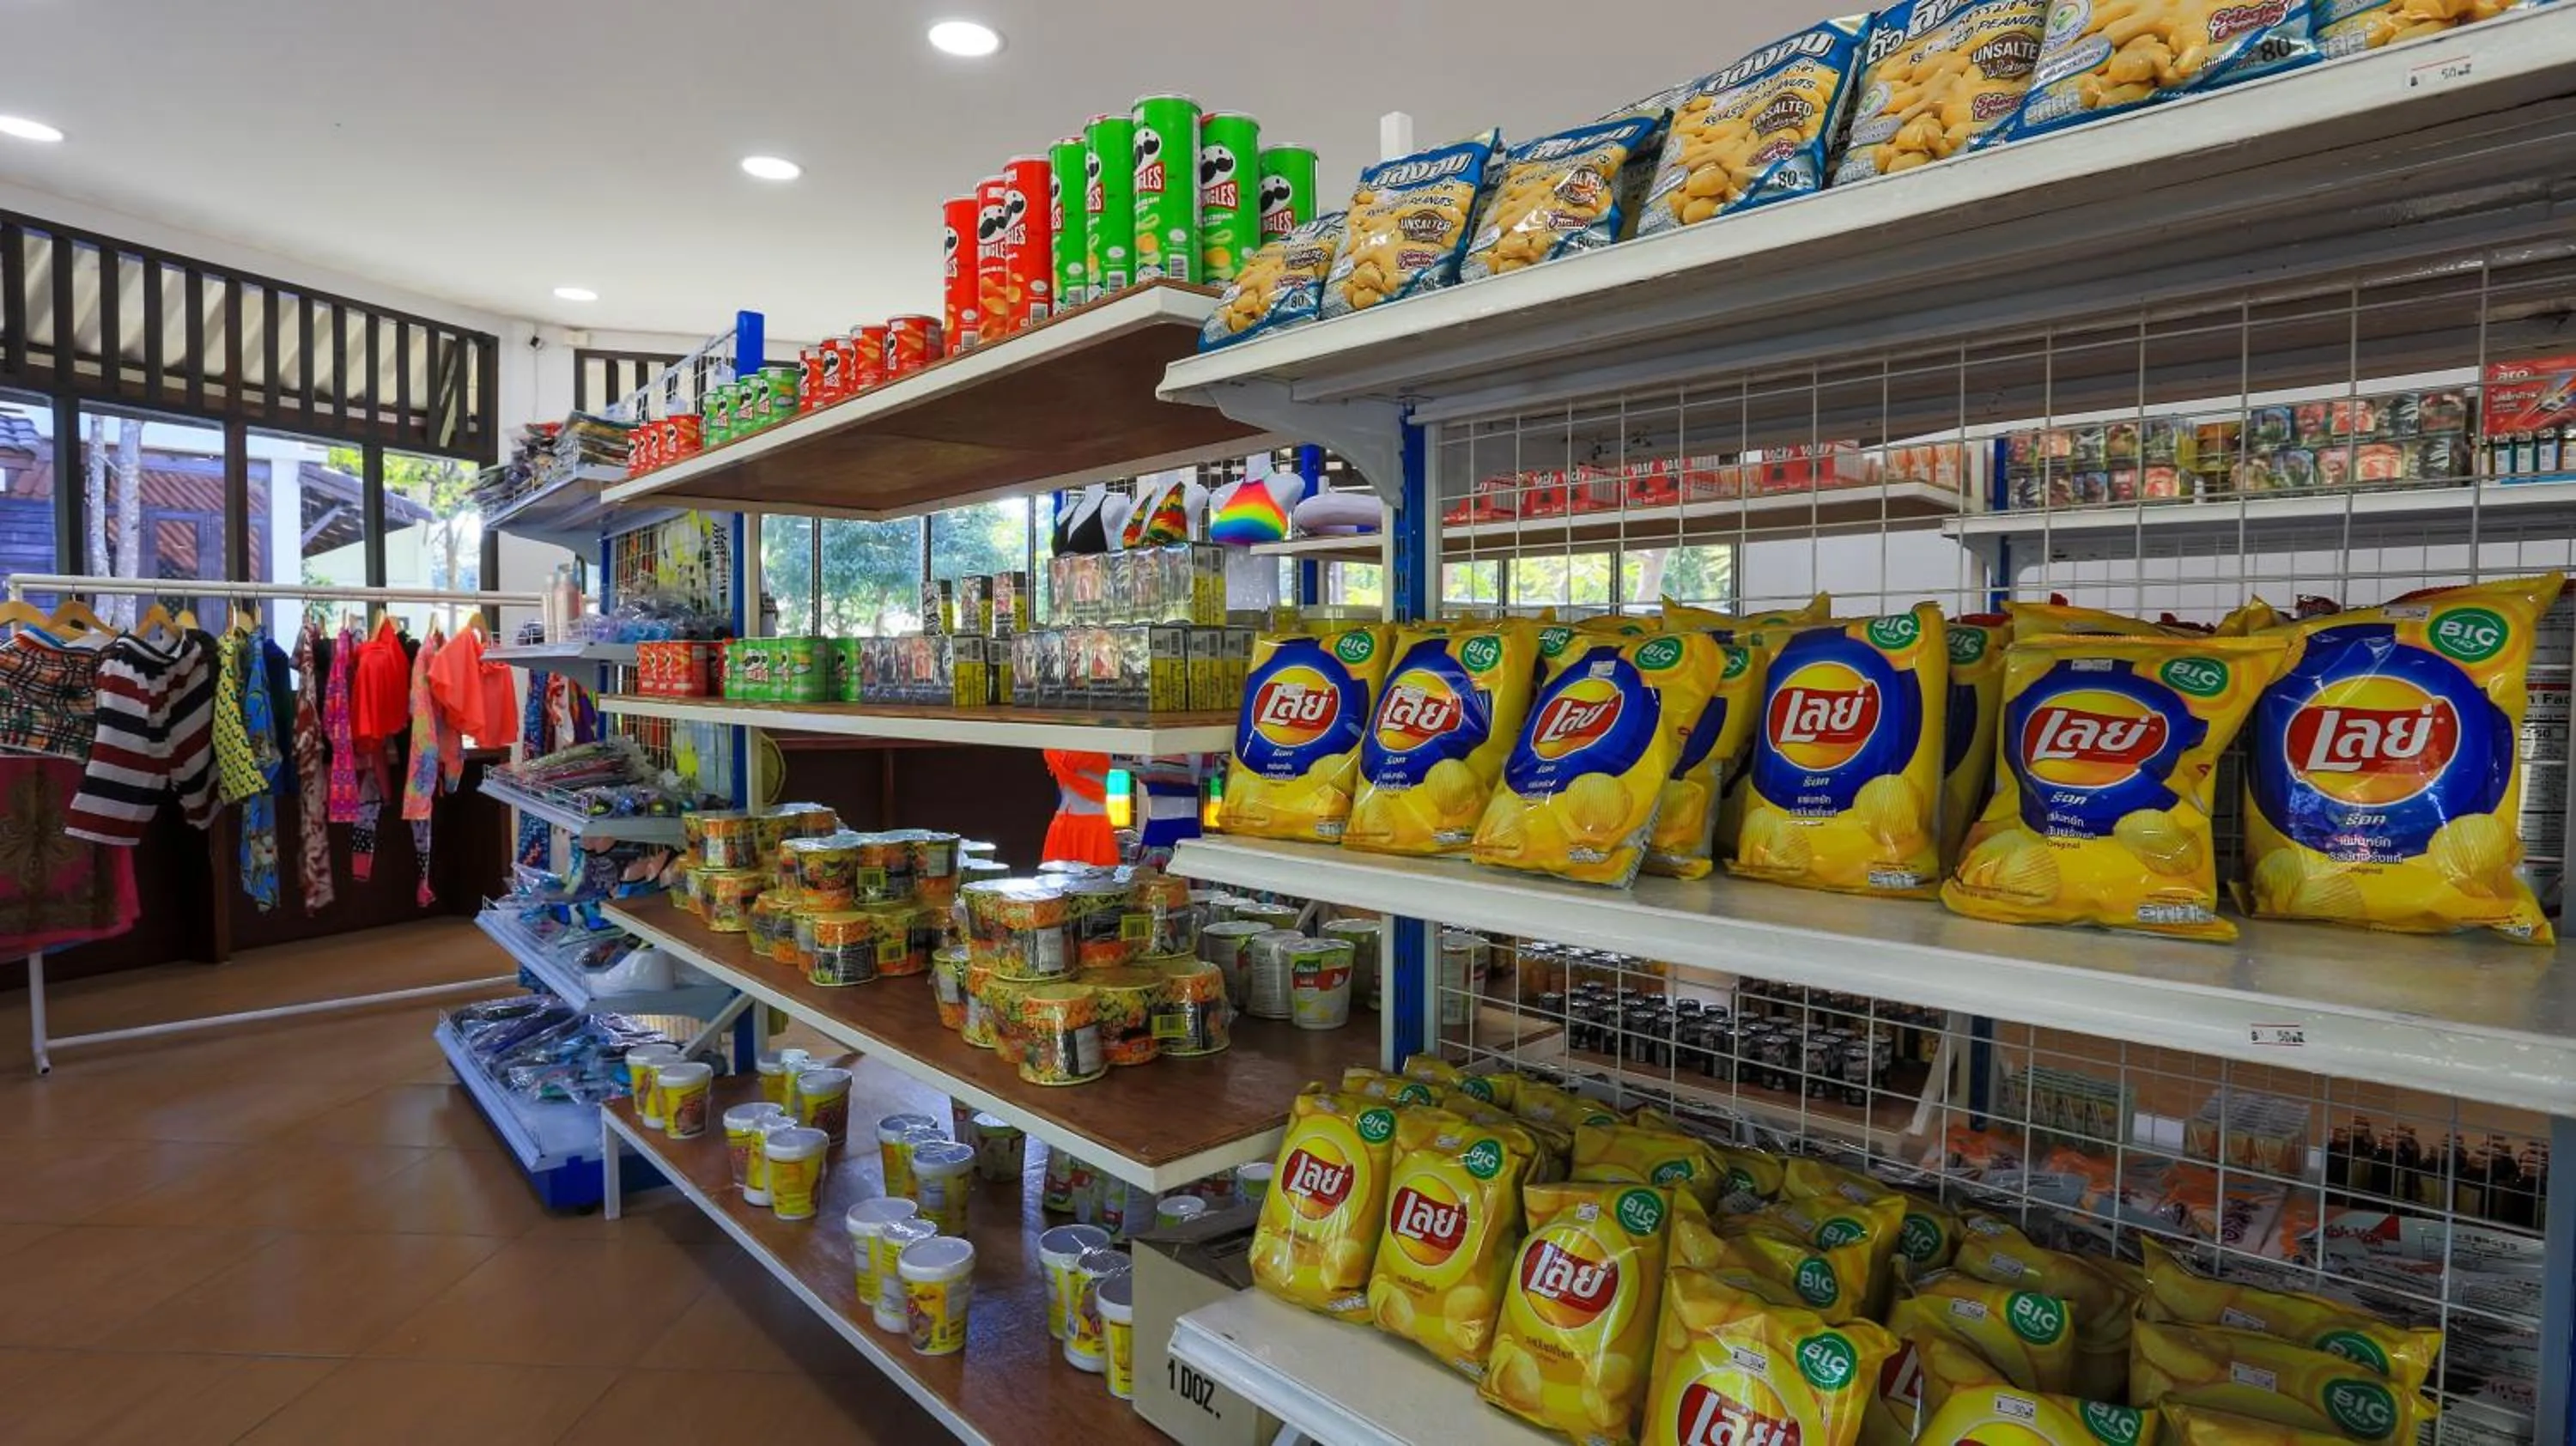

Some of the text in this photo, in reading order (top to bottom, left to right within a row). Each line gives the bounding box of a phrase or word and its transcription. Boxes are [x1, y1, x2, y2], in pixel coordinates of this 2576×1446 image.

[1971, 42, 2041, 64] UNSALTE
[2260, 36, 2292, 62] 80
[1341, 636, 1370, 653] BIG
[2438, 620, 2499, 646] BIG
[1467, 640, 1497, 660] BIG
[1642, 643, 1675, 662] BIG
[2170, 661, 2221, 689] BIG
[1363, 1113, 1388, 1134] BIG
[1471, 1145, 1498, 1168] BIG
[1622, 1197, 1660, 1226] BIG
[1800, 1272, 1836, 1294] BIG
[2016, 1295, 2058, 1332] BIG
[1804, 1342, 1848, 1375] BIG
[1167, 1358, 1222, 1420] 1 DOZ.
[2087, 1400, 2137, 1438] BIG
[2333, 1386, 2391, 1427] BIG
